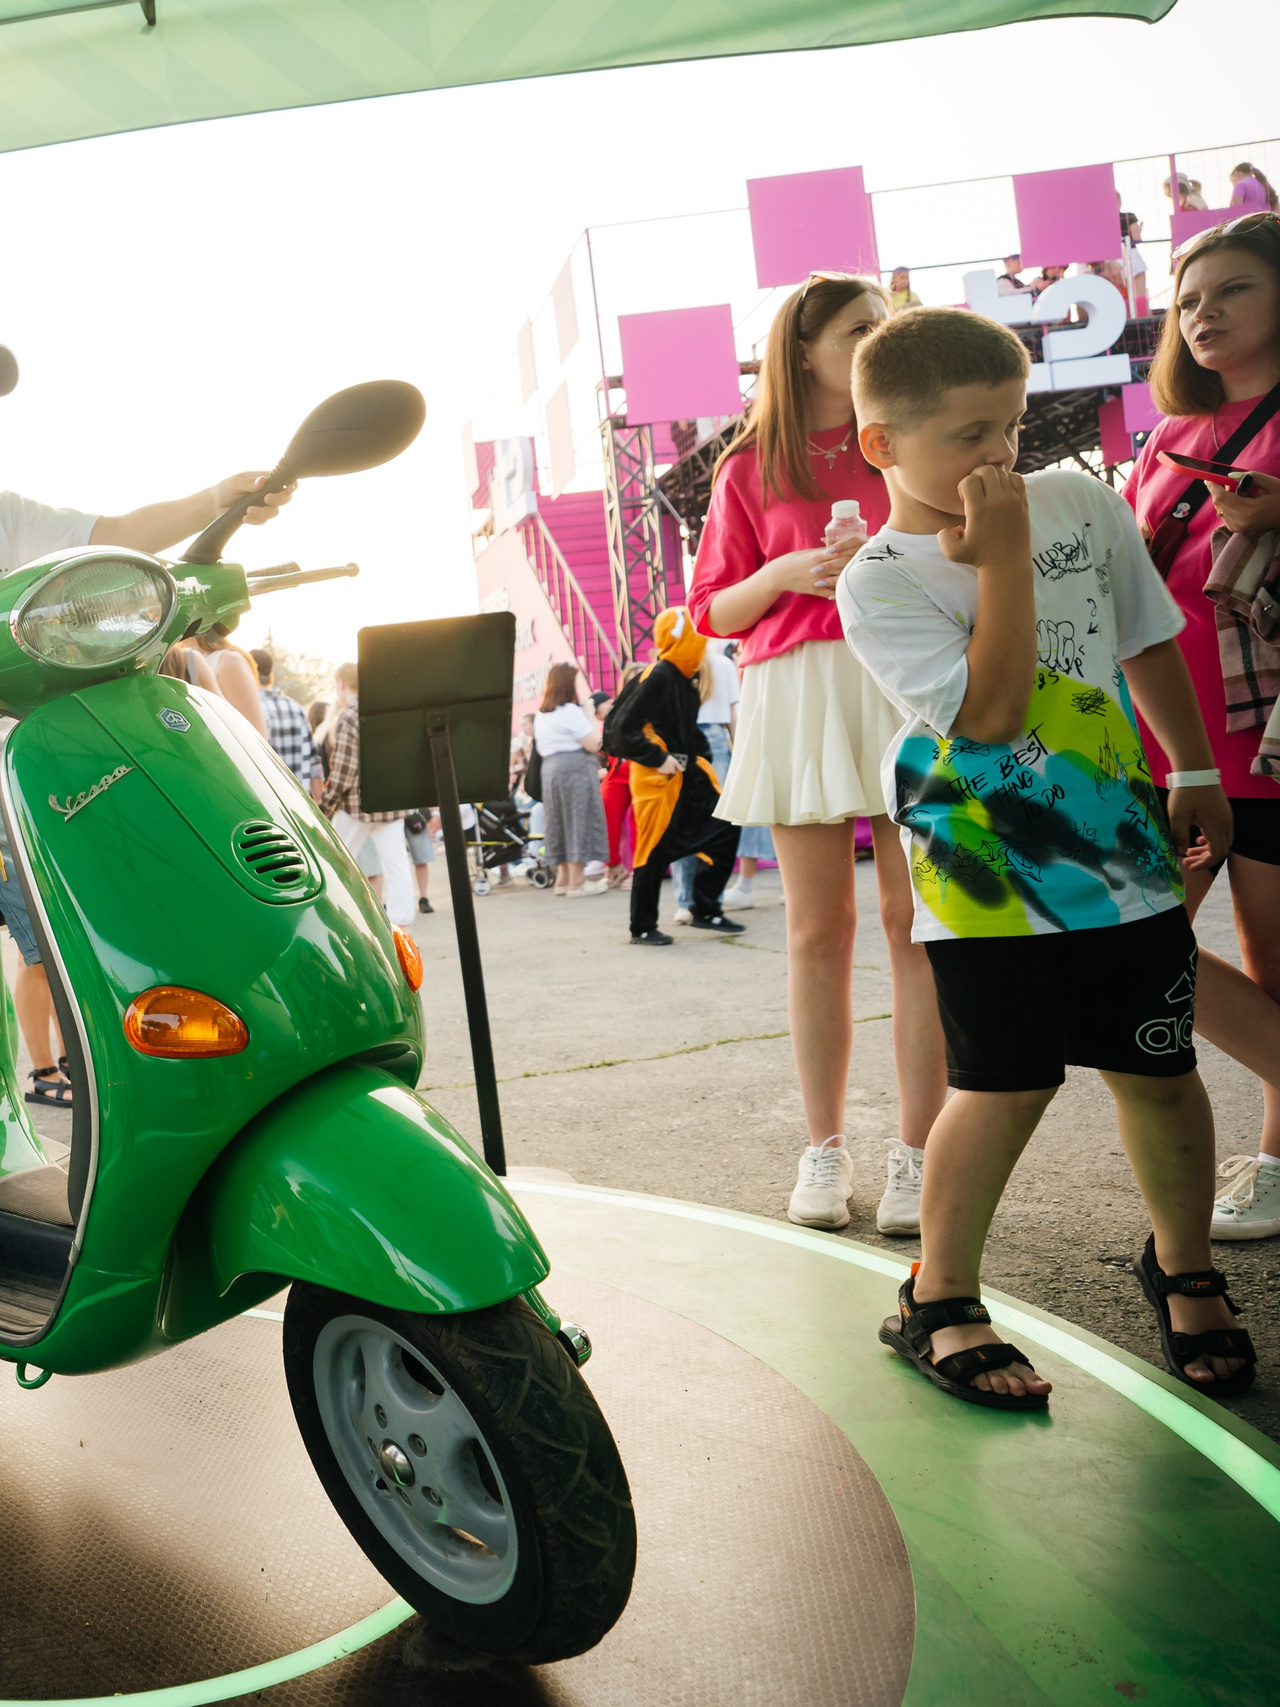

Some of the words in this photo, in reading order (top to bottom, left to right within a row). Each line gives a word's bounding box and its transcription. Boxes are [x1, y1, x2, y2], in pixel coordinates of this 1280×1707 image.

[48, 764, 135, 823] Vespa
[943, 771, 990, 806] THE
[993, 722, 1049, 781] BEST
[1040, 783, 1066, 810] DO
